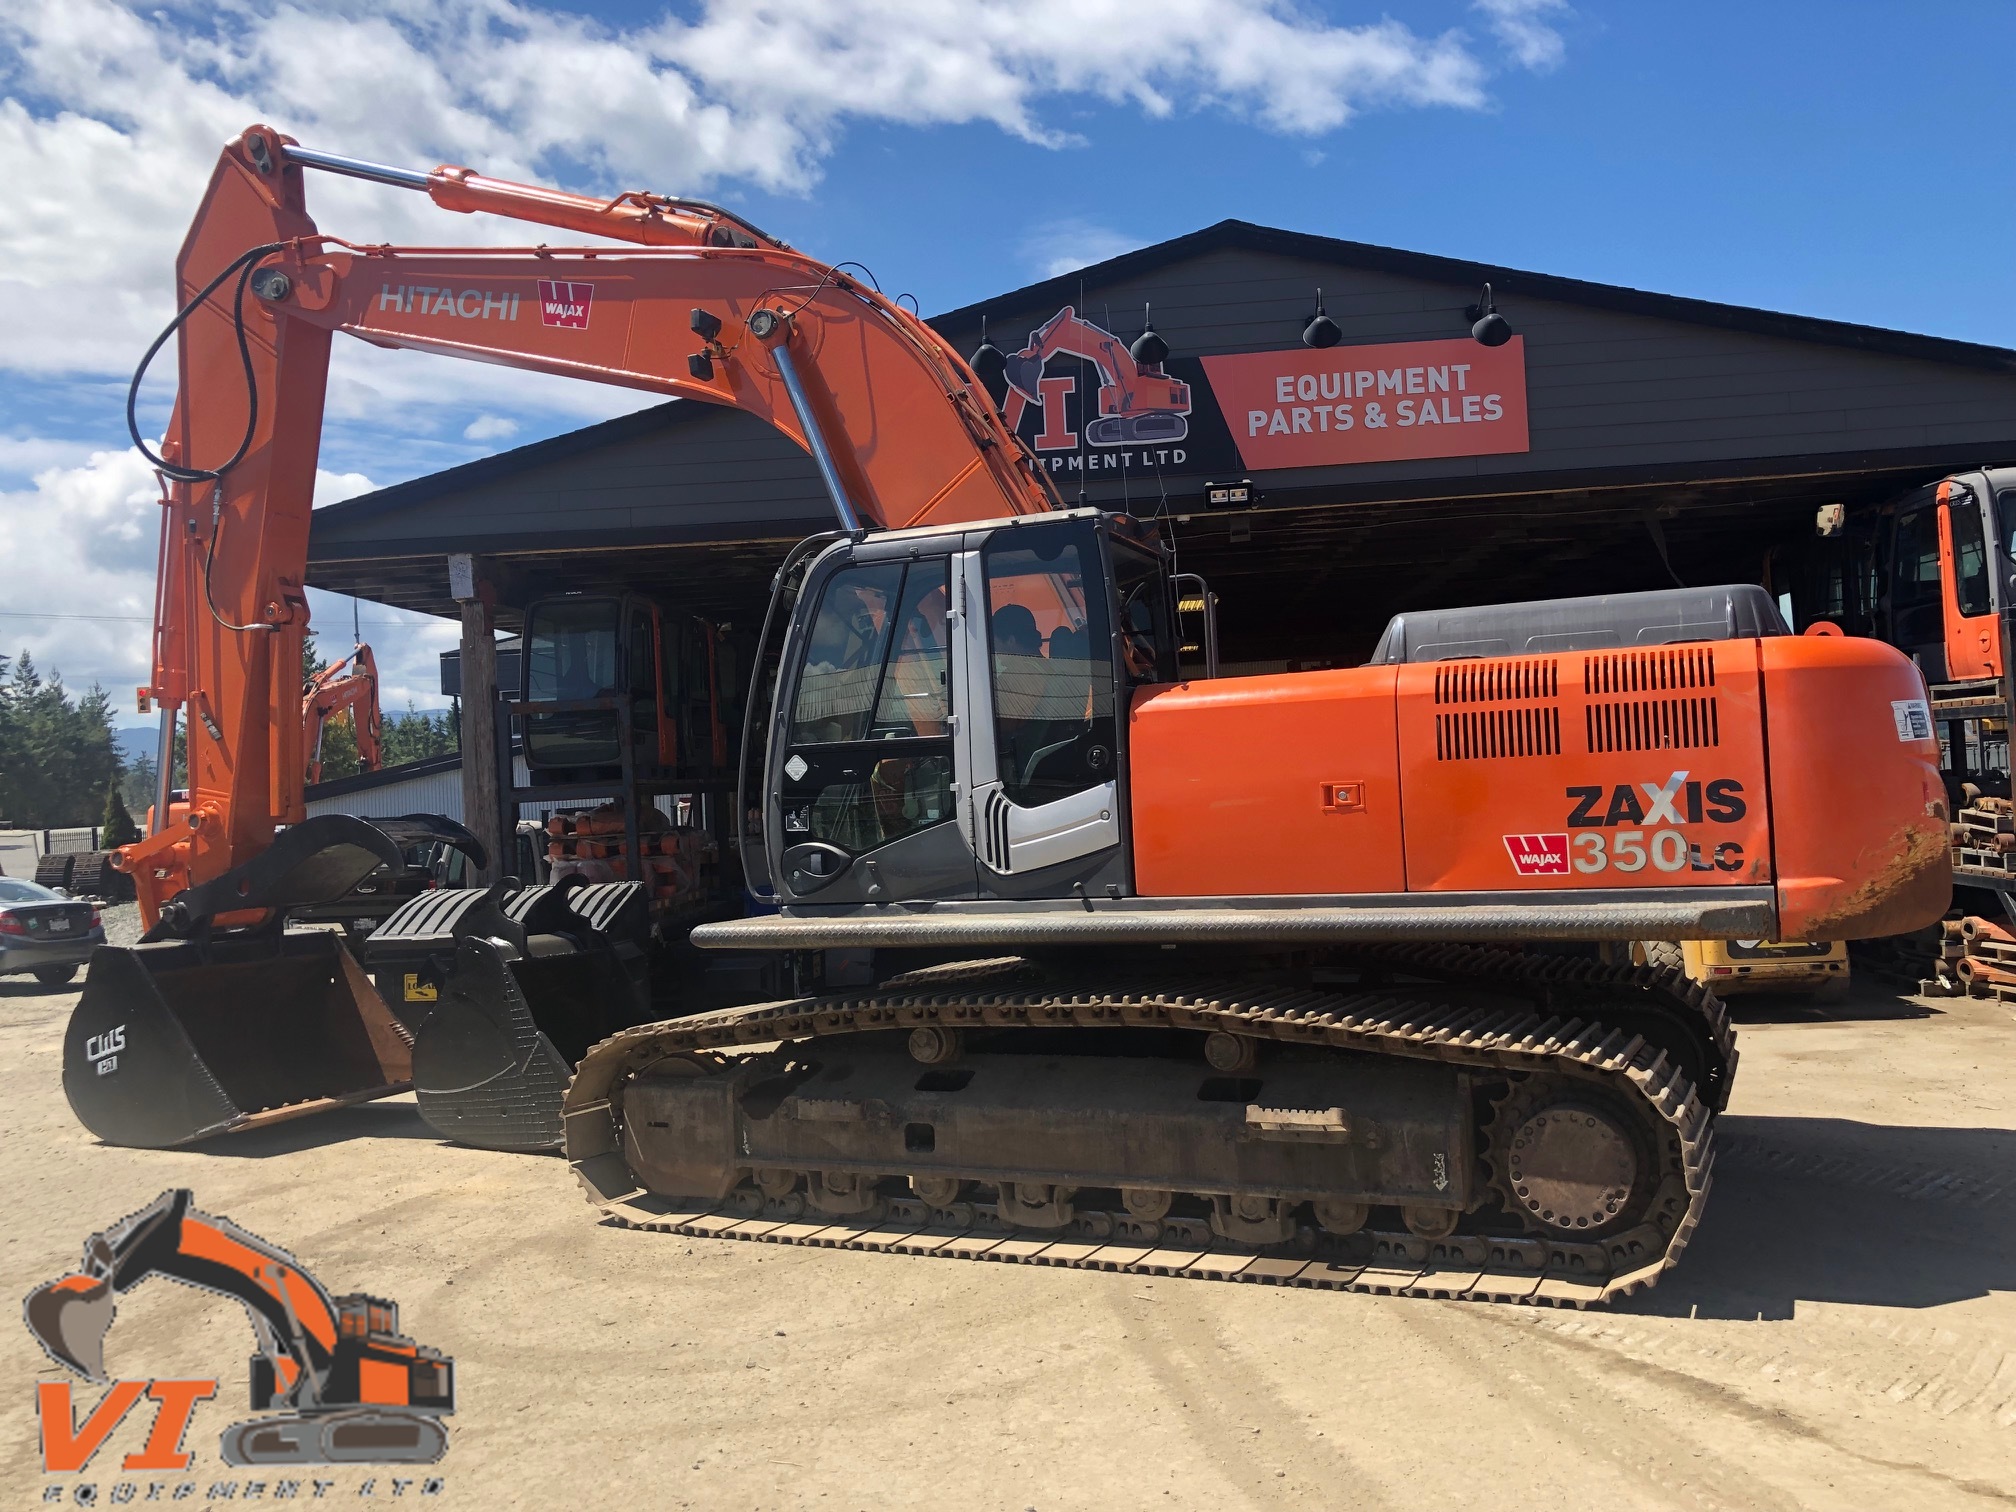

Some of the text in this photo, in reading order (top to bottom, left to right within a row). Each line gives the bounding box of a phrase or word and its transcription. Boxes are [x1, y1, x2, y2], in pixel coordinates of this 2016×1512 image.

[380, 284, 519, 320] HITACHI
[545, 302, 585, 318] WAJAX
[1277, 364, 1470, 402] EQUIPMENT
[1248, 393, 1504, 438] PARTS & SALES
[1142, 449, 1187, 466] LTD
[1566, 771, 1747, 827] ZAXIS
[1519, 852, 1563, 867] WAJAX
